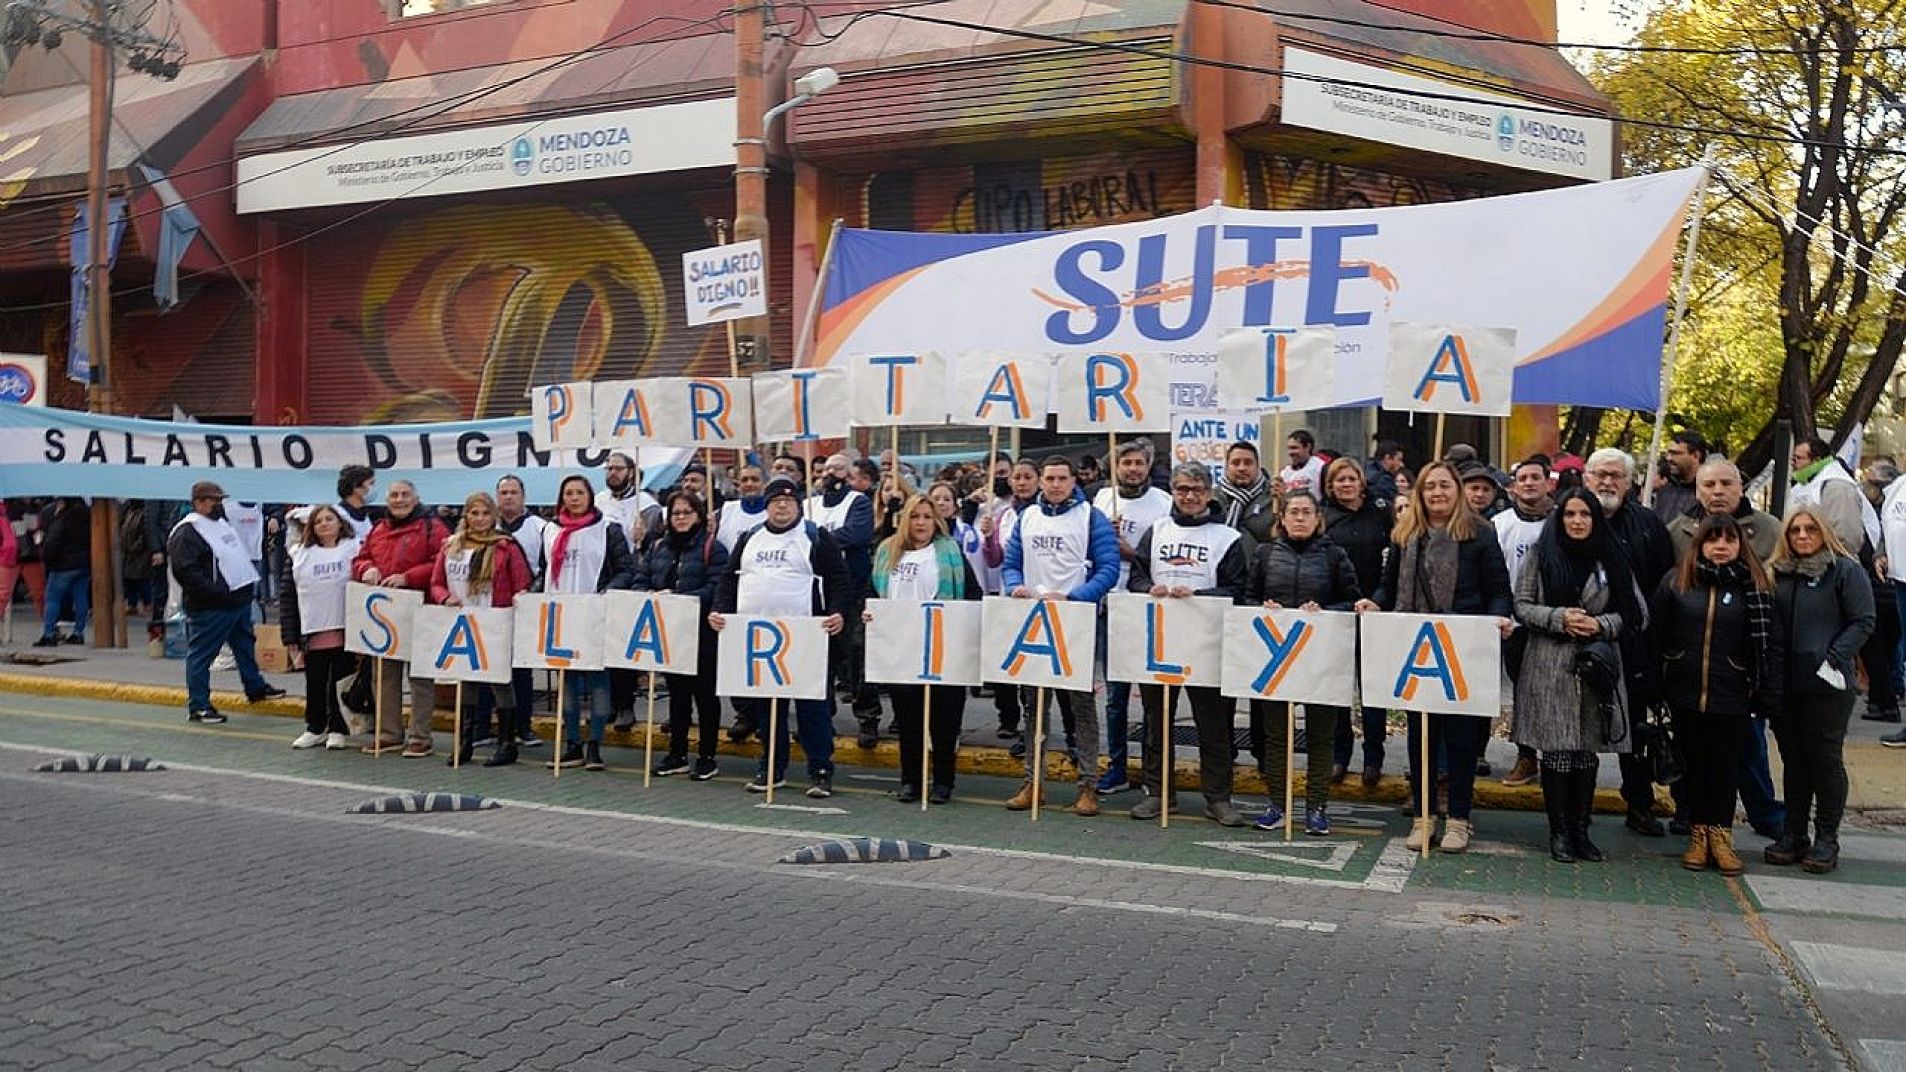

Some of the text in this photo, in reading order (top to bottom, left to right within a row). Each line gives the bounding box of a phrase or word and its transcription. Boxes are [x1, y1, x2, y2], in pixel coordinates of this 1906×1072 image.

[539, 127, 631, 153] MENDOZA
[1519, 118, 1586, 147] MENDOZA
[539, 149, 633, 174] GOBIERNO
[1518, 139, 1586, 167] GOBIERNO
[688, 250, 762, 282] SALARIO
[1045, 223, 1379, 346] SUTE
[1169, 351, 1218, 366] Trabaja
[1169, 382, 1218, 407] TERA
[1179, 418, 1260, 441] ANTE UN
[44, 427, 314, 470] SALARIO
[1031, 535, 1064, 550] SUTE
[1158, 542, 1209, 563] SUTE
[312, 560, 345, 576] SUTE
[755, 549, 789, 563] SUTE
